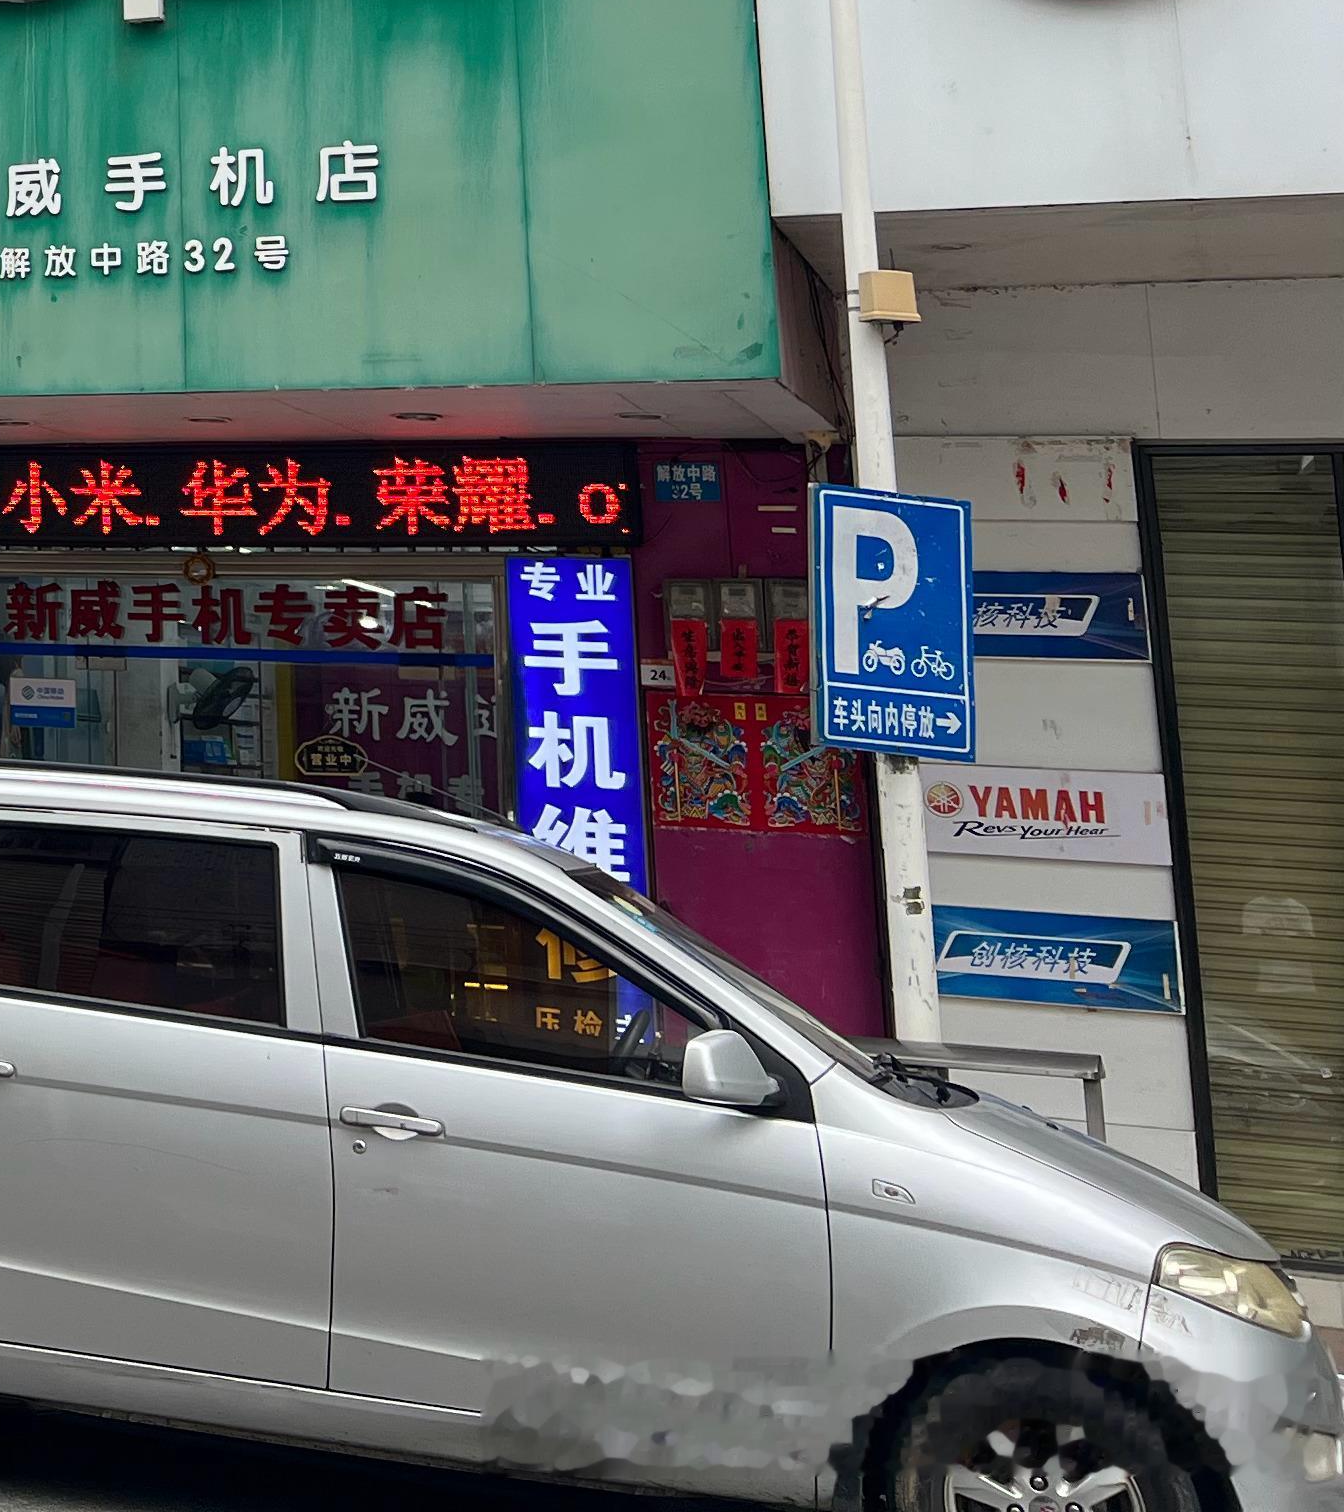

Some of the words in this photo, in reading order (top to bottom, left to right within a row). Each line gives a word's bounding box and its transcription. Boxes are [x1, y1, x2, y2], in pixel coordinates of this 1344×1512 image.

[0, 236, 290, 281] 解放中路32号
[656, 464, 717, 483] 解放中路
[520, 561, 617, 602] 专业
[4, 582, 449, 651] 新威手机专卖店
[650, 669, 666, 682] 24
[832, 695, 936, 741] 车头向内停放
[310, 753, 353, 767] 营业中
[953, 820, 1018, 838] Revs
[1019, 823, 1063, 840] Your
[970, 940, 1098, 976] 创核科技
